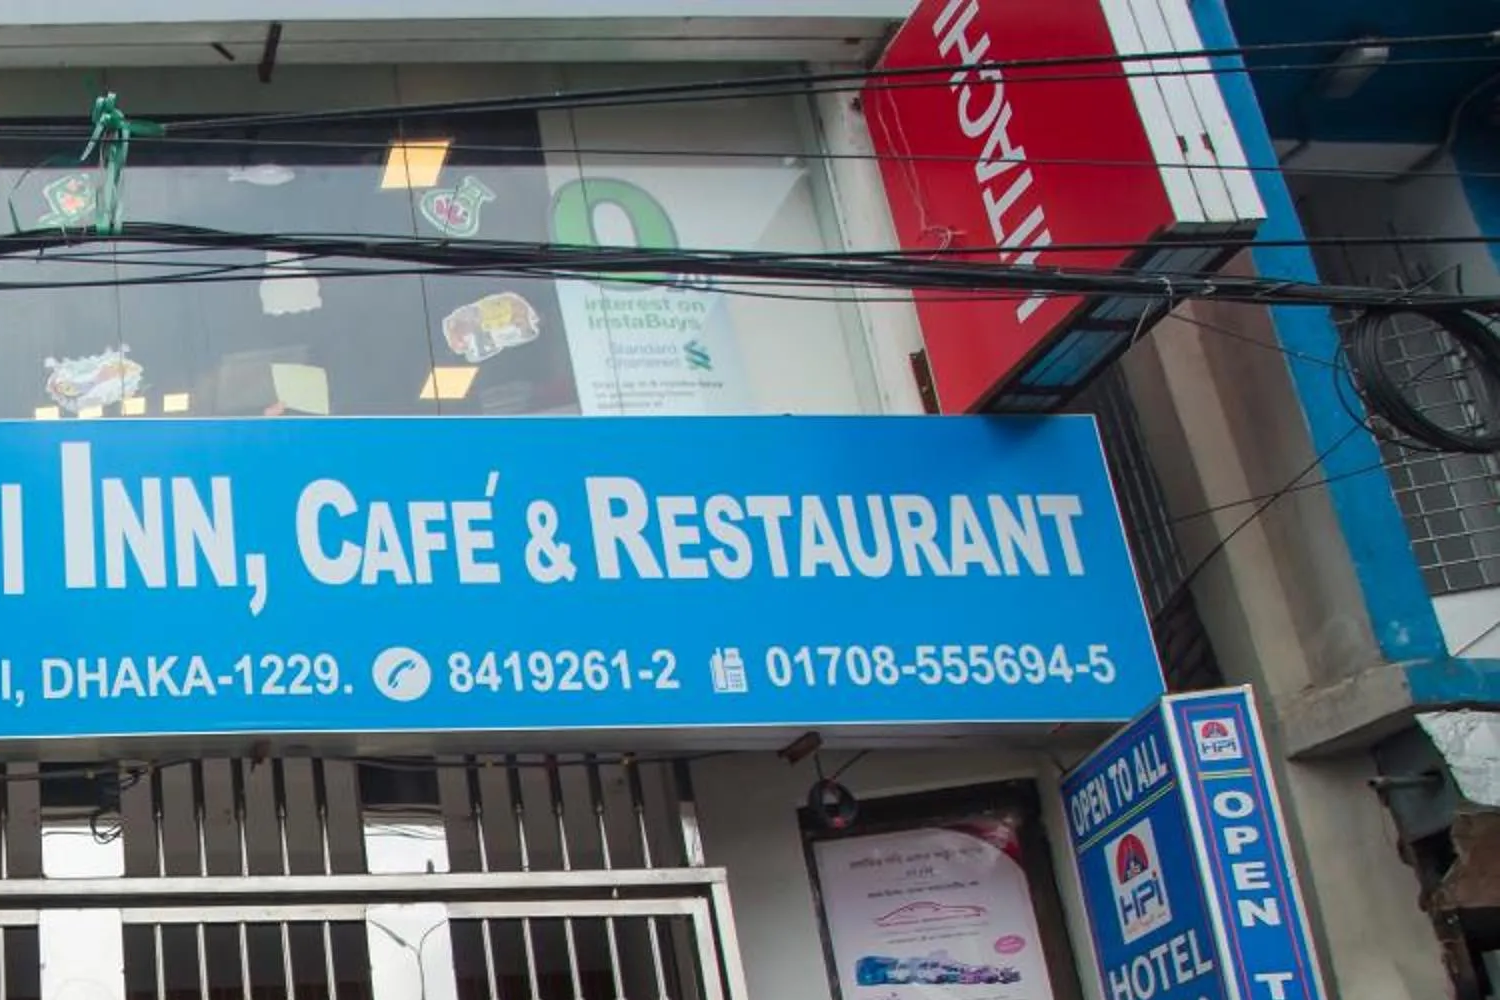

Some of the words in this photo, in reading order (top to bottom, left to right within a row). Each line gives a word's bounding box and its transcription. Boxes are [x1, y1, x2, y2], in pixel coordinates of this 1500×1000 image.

[585, 296, 670, 313] interest
[677, 301, 706, 314] on
[525, 500, 578, 584] &
[584, 476, 1085, 579] RESTAURANT
[41, 653, 354, 699] DHAKA-1229.
[448, 649, 680, 693] 8419261-2
[765, 644, 1117, 687] 01708-555694-5
[1070, 777, 1112, 837] OPEN
[1107, 756, 1134, 809] TO
[1135, 735, 1169, 790] ALL
[1213, 790, 1282, 928] OPEN
